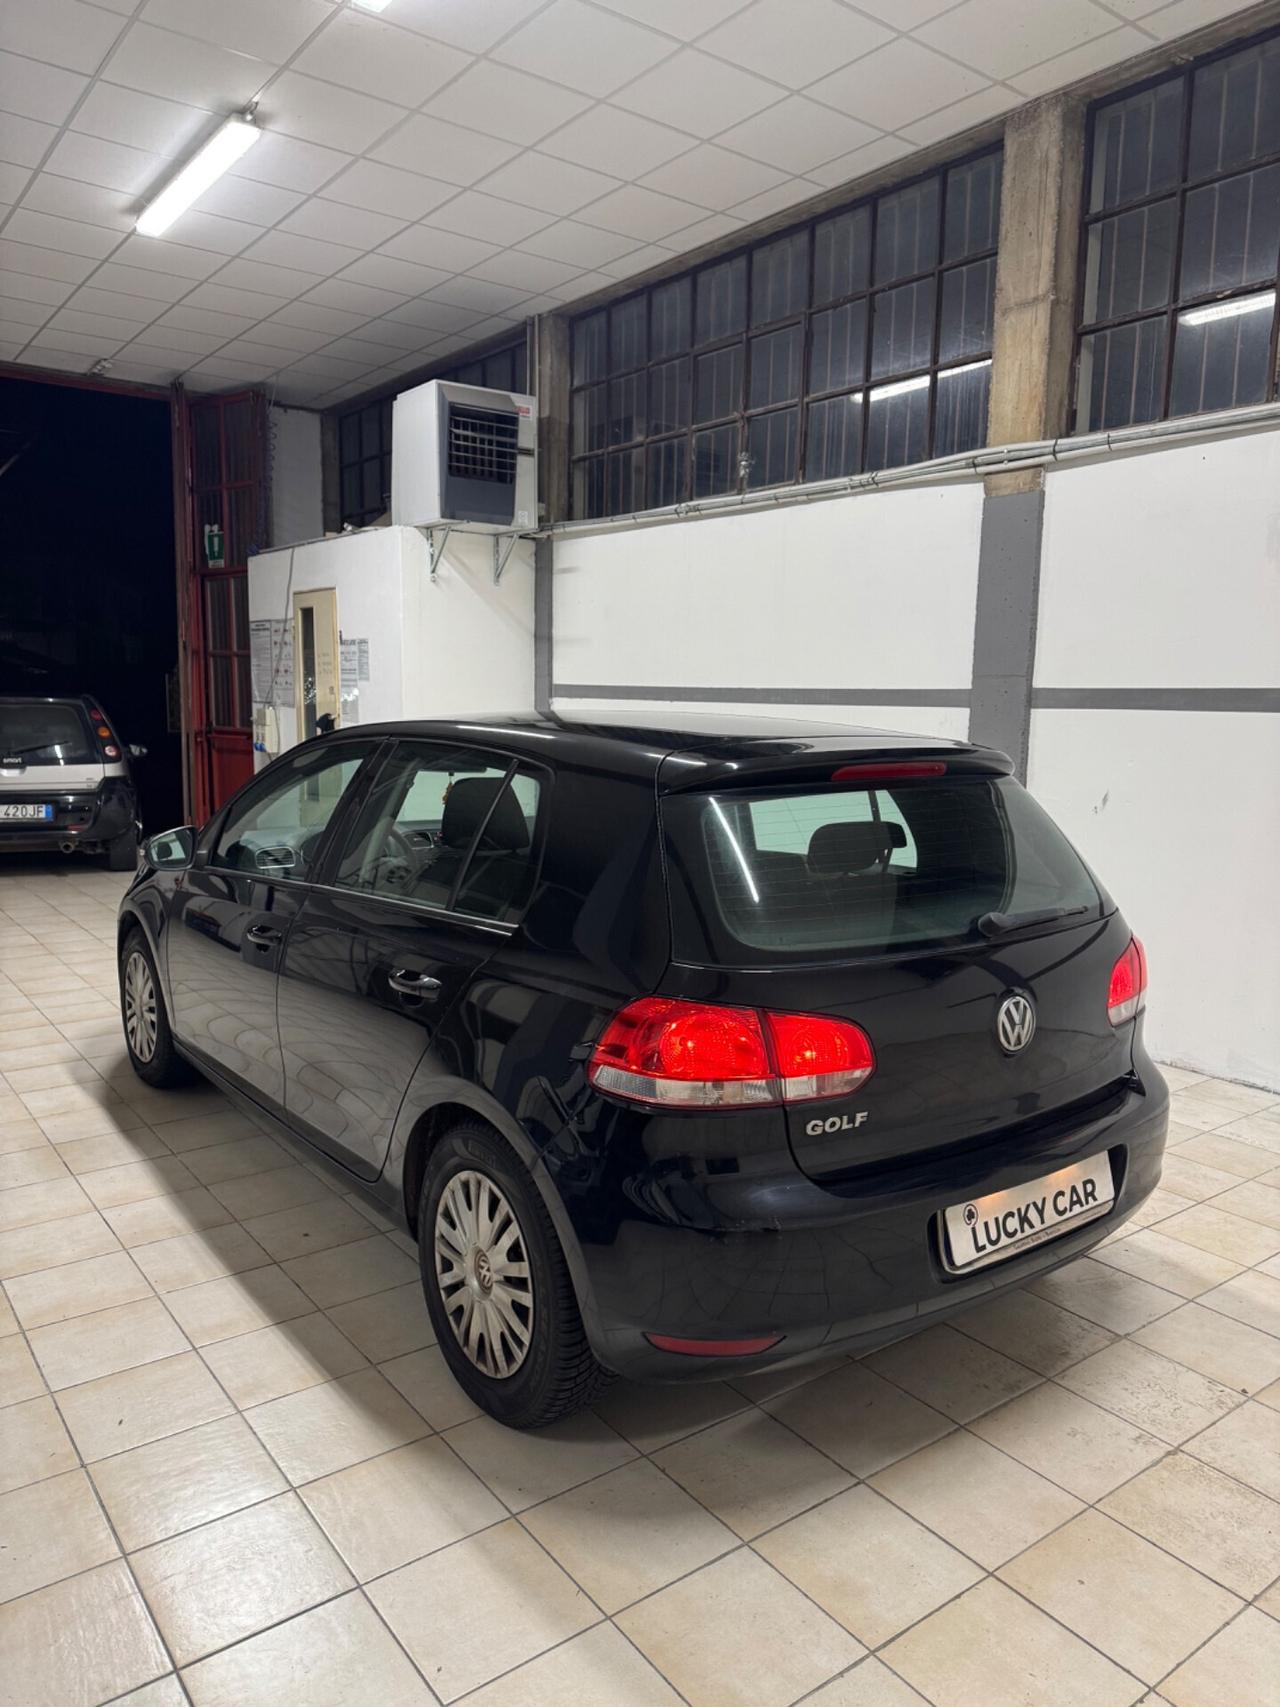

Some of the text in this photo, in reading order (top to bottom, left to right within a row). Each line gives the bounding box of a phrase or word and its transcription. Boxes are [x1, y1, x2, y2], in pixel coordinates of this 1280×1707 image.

[806, 1111, 869, 1136] GOLF
[971, 1196, 1047, 1254] LUCKY
[1053, 1178, 1098, 1217] CAR
